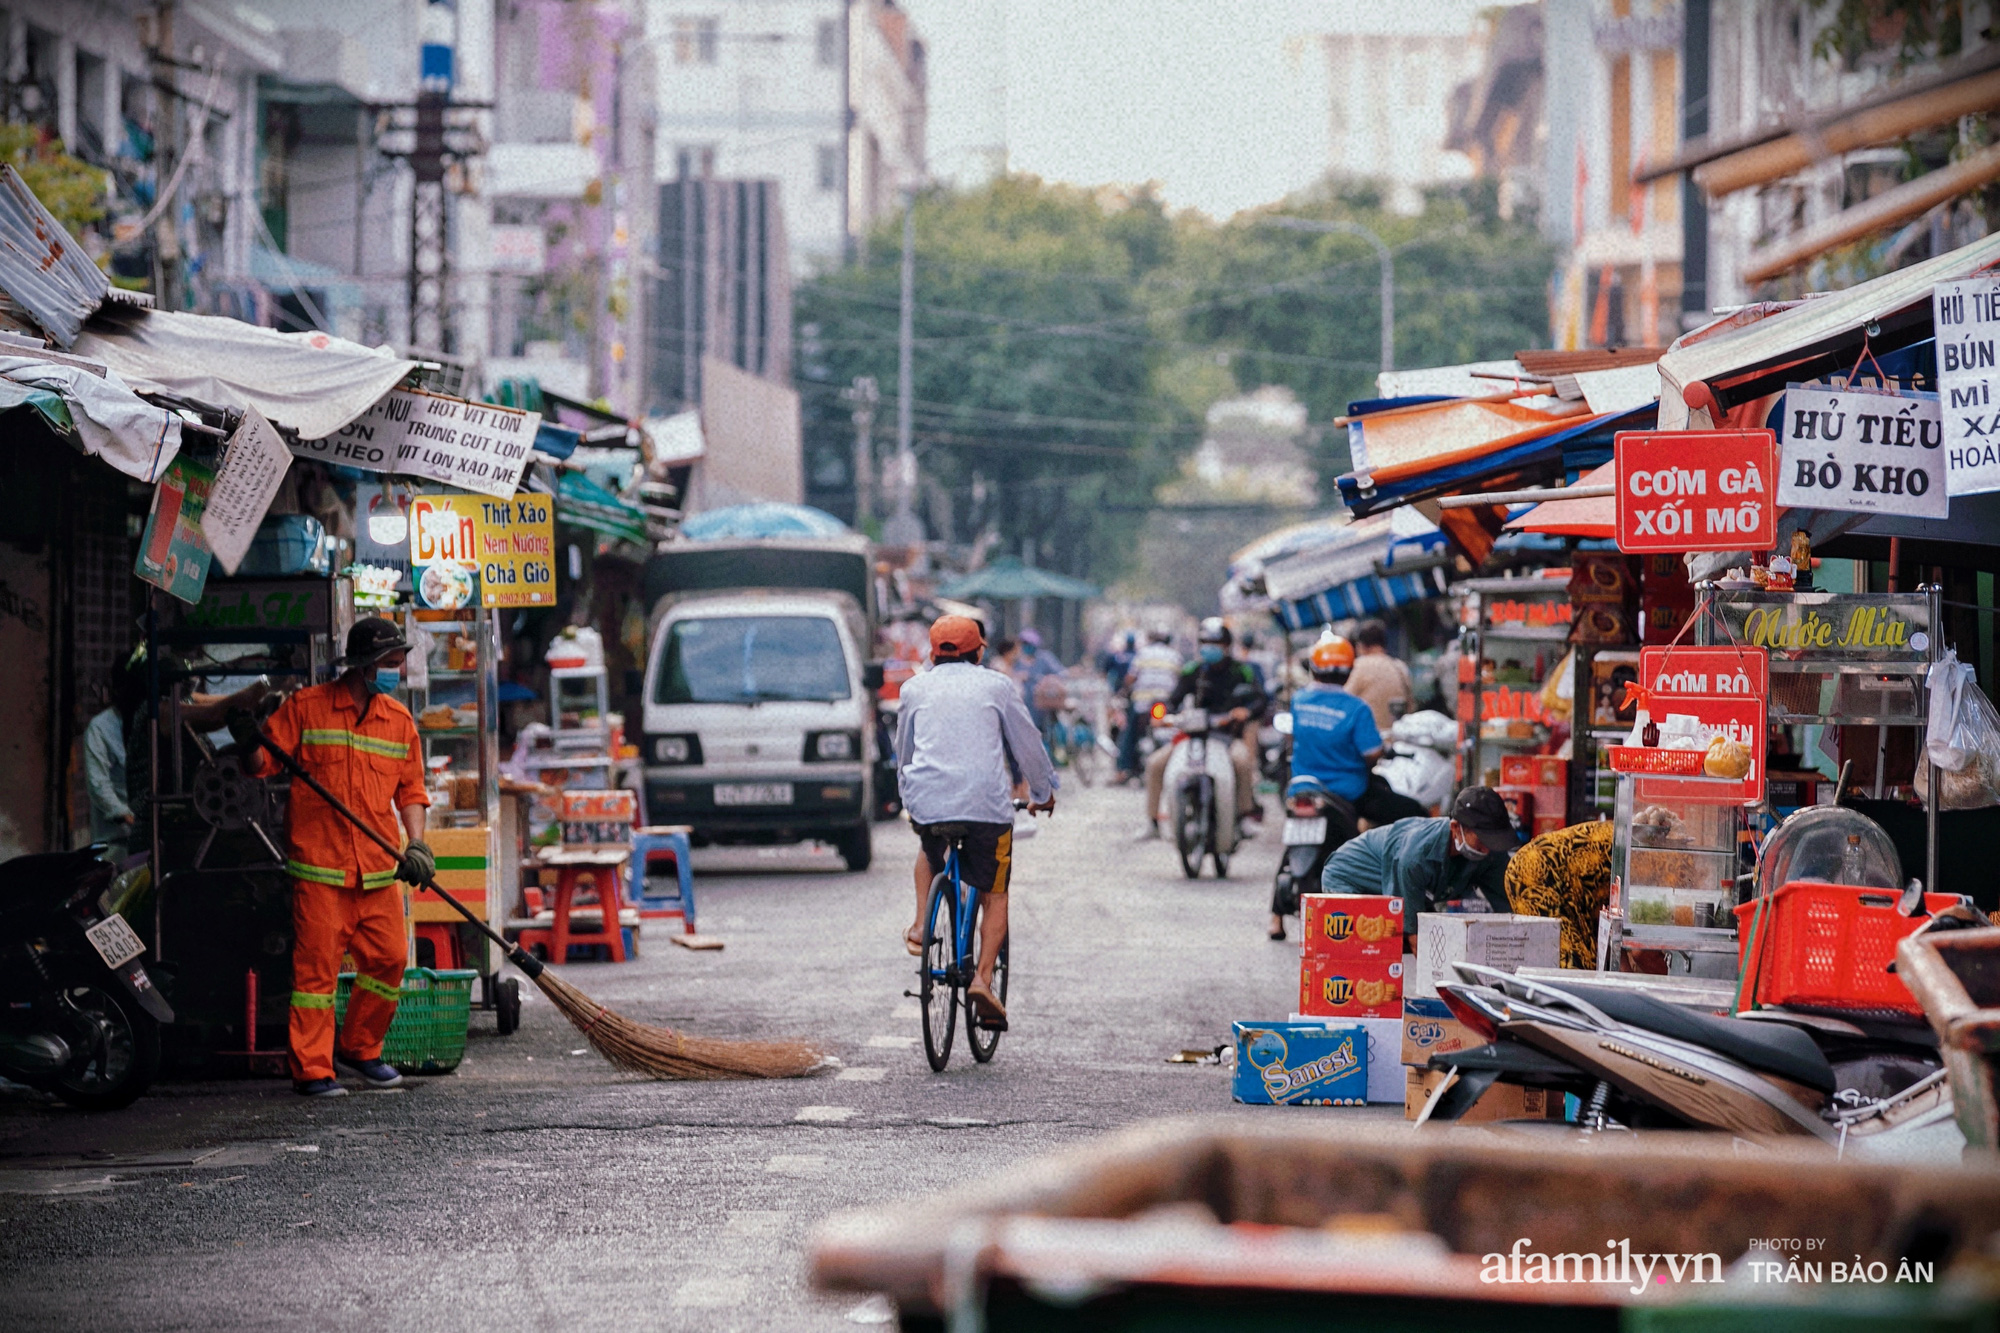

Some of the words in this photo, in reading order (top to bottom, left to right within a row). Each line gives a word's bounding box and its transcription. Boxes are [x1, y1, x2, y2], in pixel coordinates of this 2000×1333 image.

[1940, 286, 1965, 325] HỦ
[1943, 333, 1995, 372] BÚN
[1950, 379, 1989, 408] MÌ
[1792, 398, 1846, 441] HỦ
[1857, 403, 1942, 449] TIẾU
[335, 441, 384, 462] HEO
[1950, 439, 2000, 470] HOÀ
[1629, 466, 1706, 497] CƠM
[1718, 461, 1764, 494] GÀ
[1794, 452, 1842, 489] BÒ
[1852, 463, 1929, 496] KHO
[482, 503, 511, 529] Thịt
[518, 501, 546, 523] Xào
[1634, 499, 1693, 536] XỐI
[1706, 500, 1762, 534] MỠ
[483, 533, 508, 555] Nem
[486, 560, 516, 584] Chả
[523, 561, 550, 583] Giò
[1744, 608, 1833, 647] Nước
[1656, 669, 1707, 692] CƠM
[1324, 913, 1353, 937] RITZ
[1323, 978, 1353, 1001] RITZ
[1406, 1021, 1445, 1047] Gery
[1263, 1043, 1356, 1098] Sanest
